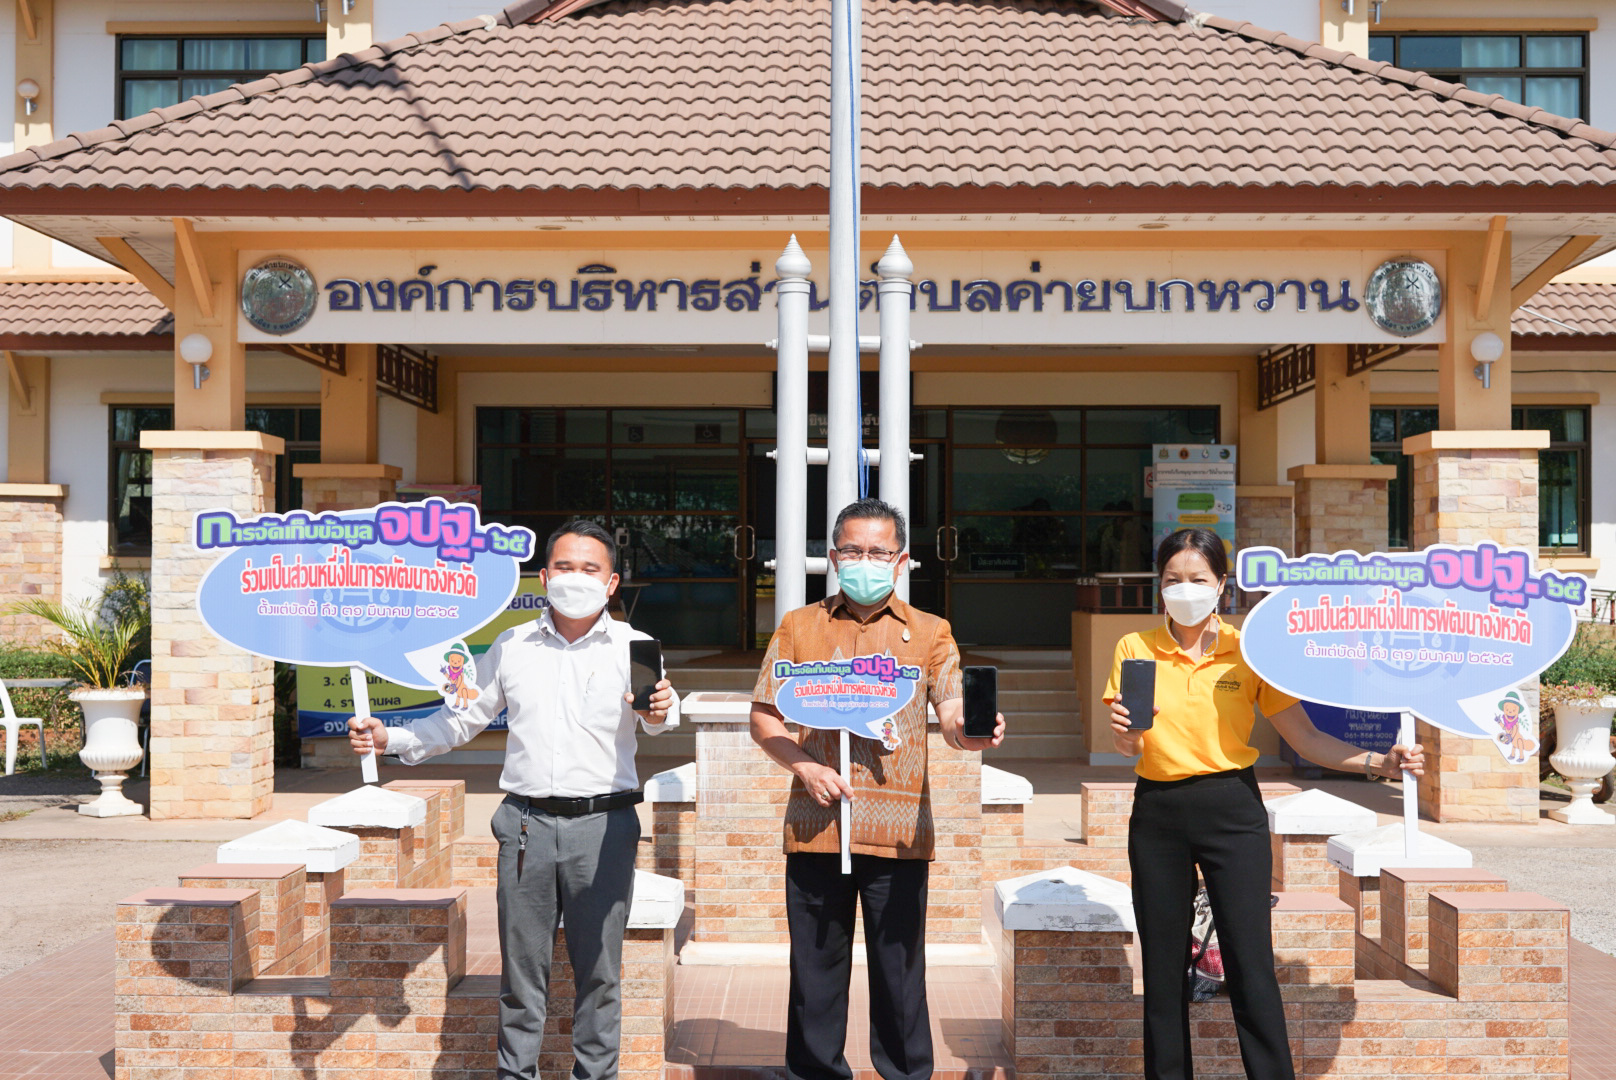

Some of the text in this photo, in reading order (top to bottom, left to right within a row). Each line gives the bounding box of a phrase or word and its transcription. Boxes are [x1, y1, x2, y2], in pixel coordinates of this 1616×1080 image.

[324, 261, 1360, 313] องค์การบริหารส่ตบลค่ายบกหวาน
[200, 504, 527, 559] การจัดเก็บข้อมูล จปฐ. ๖๕
[241, 546, 477, 598] ร่วมเป็นส่วนหนึ่งในการพัฒนาจังหวัด
[1246, 548, 1582, 605] การจัดเก็บข้อมูล จปฐ. ๖๕
[259, 599, 459, 618] ตั้งแต่บัดนี้ ถึง ๓๑ มีนาคม ๒๕๖๕
[1288, 588, 1532, 645] ร่วมเป็นส่วนหนึ่งในการพัฒนาจังหวัด
[776, 663, 851, 676] การจัดเก็บข้อมูล
[852, 656, 901, 681] จปฐ.
[1305, 641, 1513, 665] ตั้งแต่บัดนี้ ถึง ๓๑ มีนาคม ๒๕๖๕
[323, 676, 335, 687] 3.
[324, 698, 336, 708] 4.
